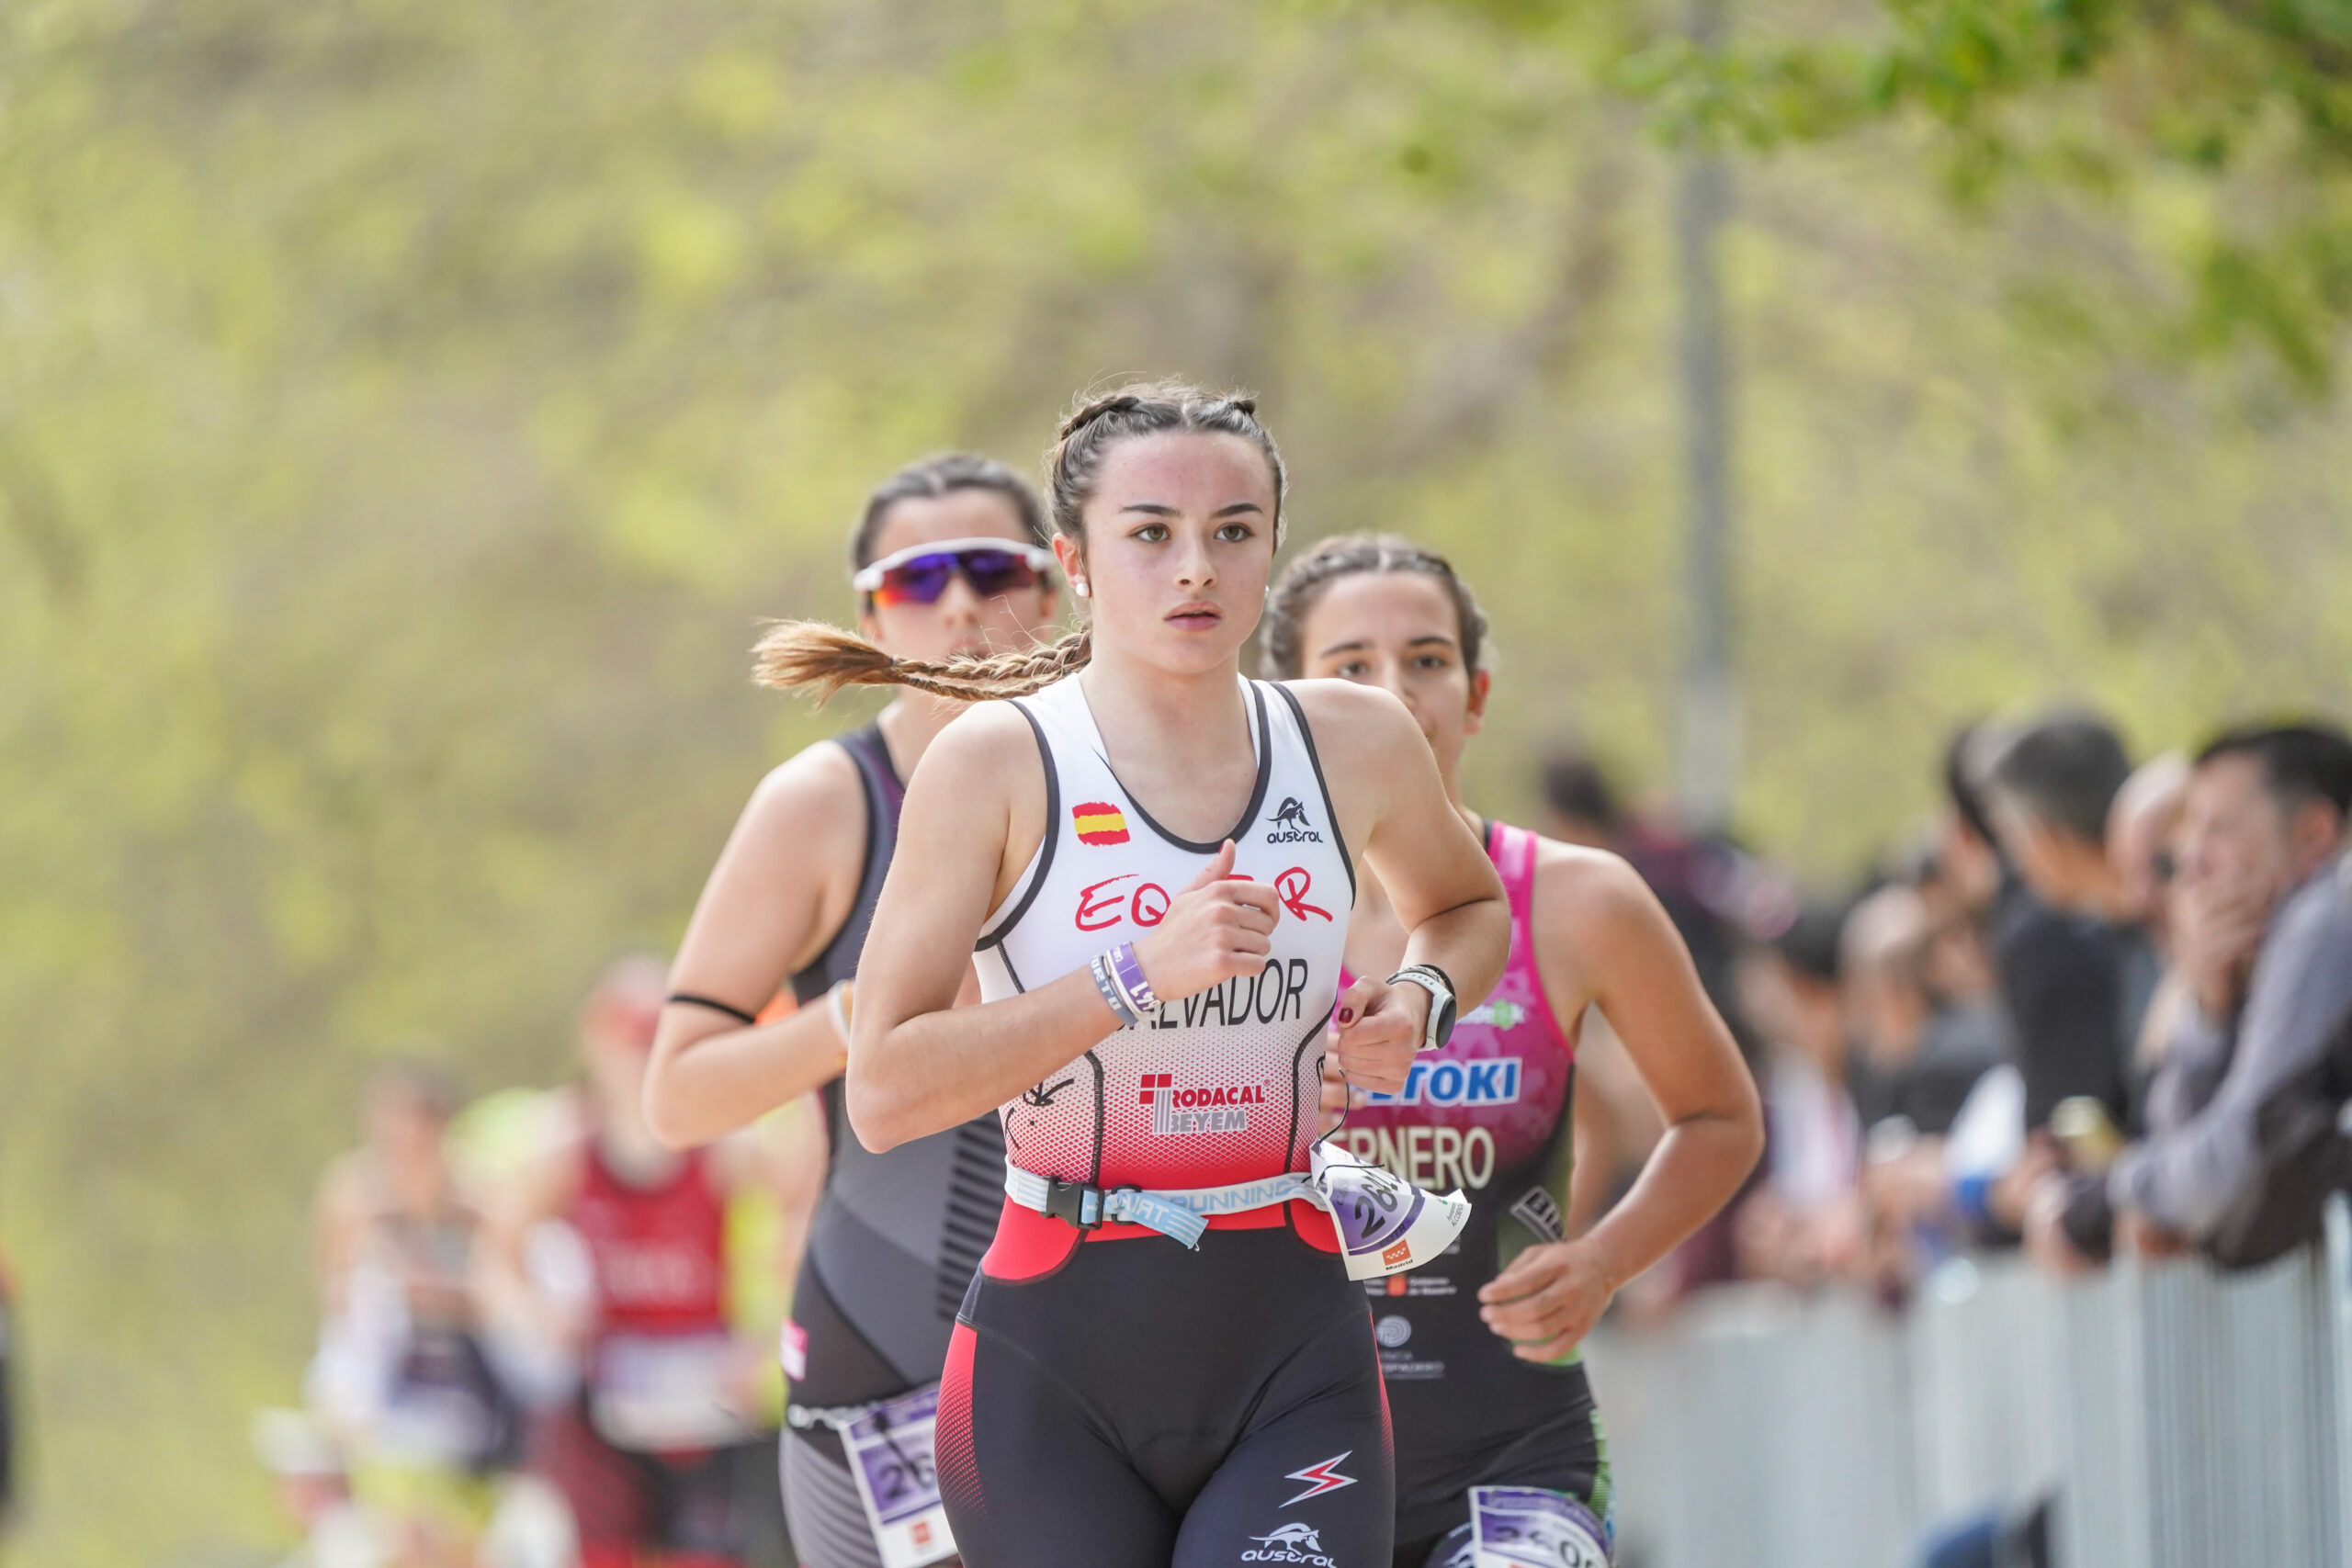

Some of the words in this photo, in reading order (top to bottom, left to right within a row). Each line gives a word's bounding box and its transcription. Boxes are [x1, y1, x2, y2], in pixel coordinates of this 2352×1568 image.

[1267, 831, 1324, 844] austral
[1091, 953, 1122, 1010] ORTO
[1116, 958, 1308, 1031] LVADOR
[1372, 1064, 1517, 1100] TOKI
[1329, 1126, 1495, 1190] RNERO
[1385, 1259, 1413, 1270] Madrid
[1241, 1550, 1337, 1568] austral
